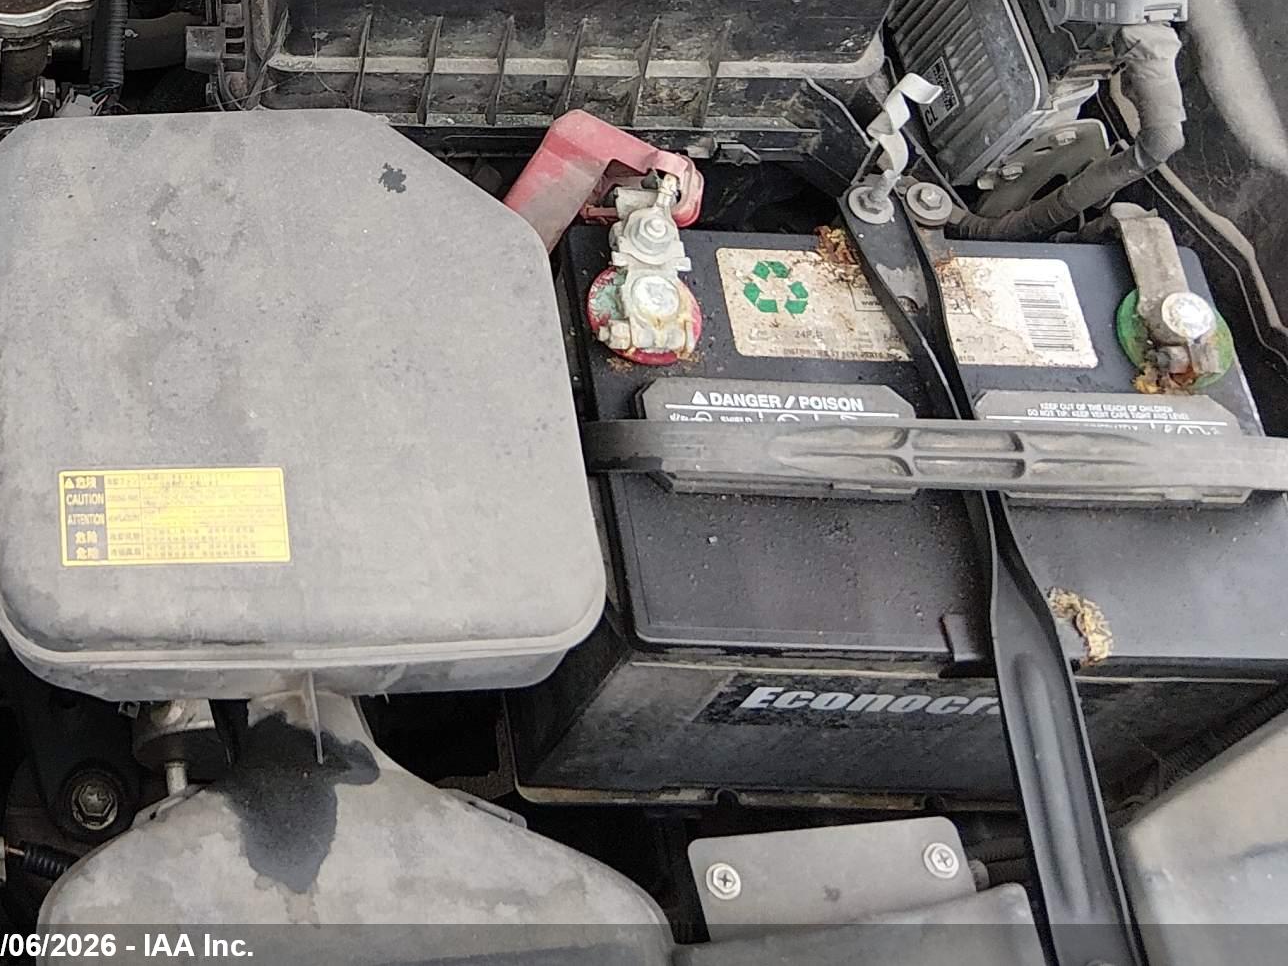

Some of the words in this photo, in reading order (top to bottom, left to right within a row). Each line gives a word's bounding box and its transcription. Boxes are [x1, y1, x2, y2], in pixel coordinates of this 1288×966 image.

[709, 391, 782, 409] DANGER
[798, 395, 865, 412] POISON
[66, 493, 104, 506] CAUTION
[67, 513, 105, 526] ATTENTION
